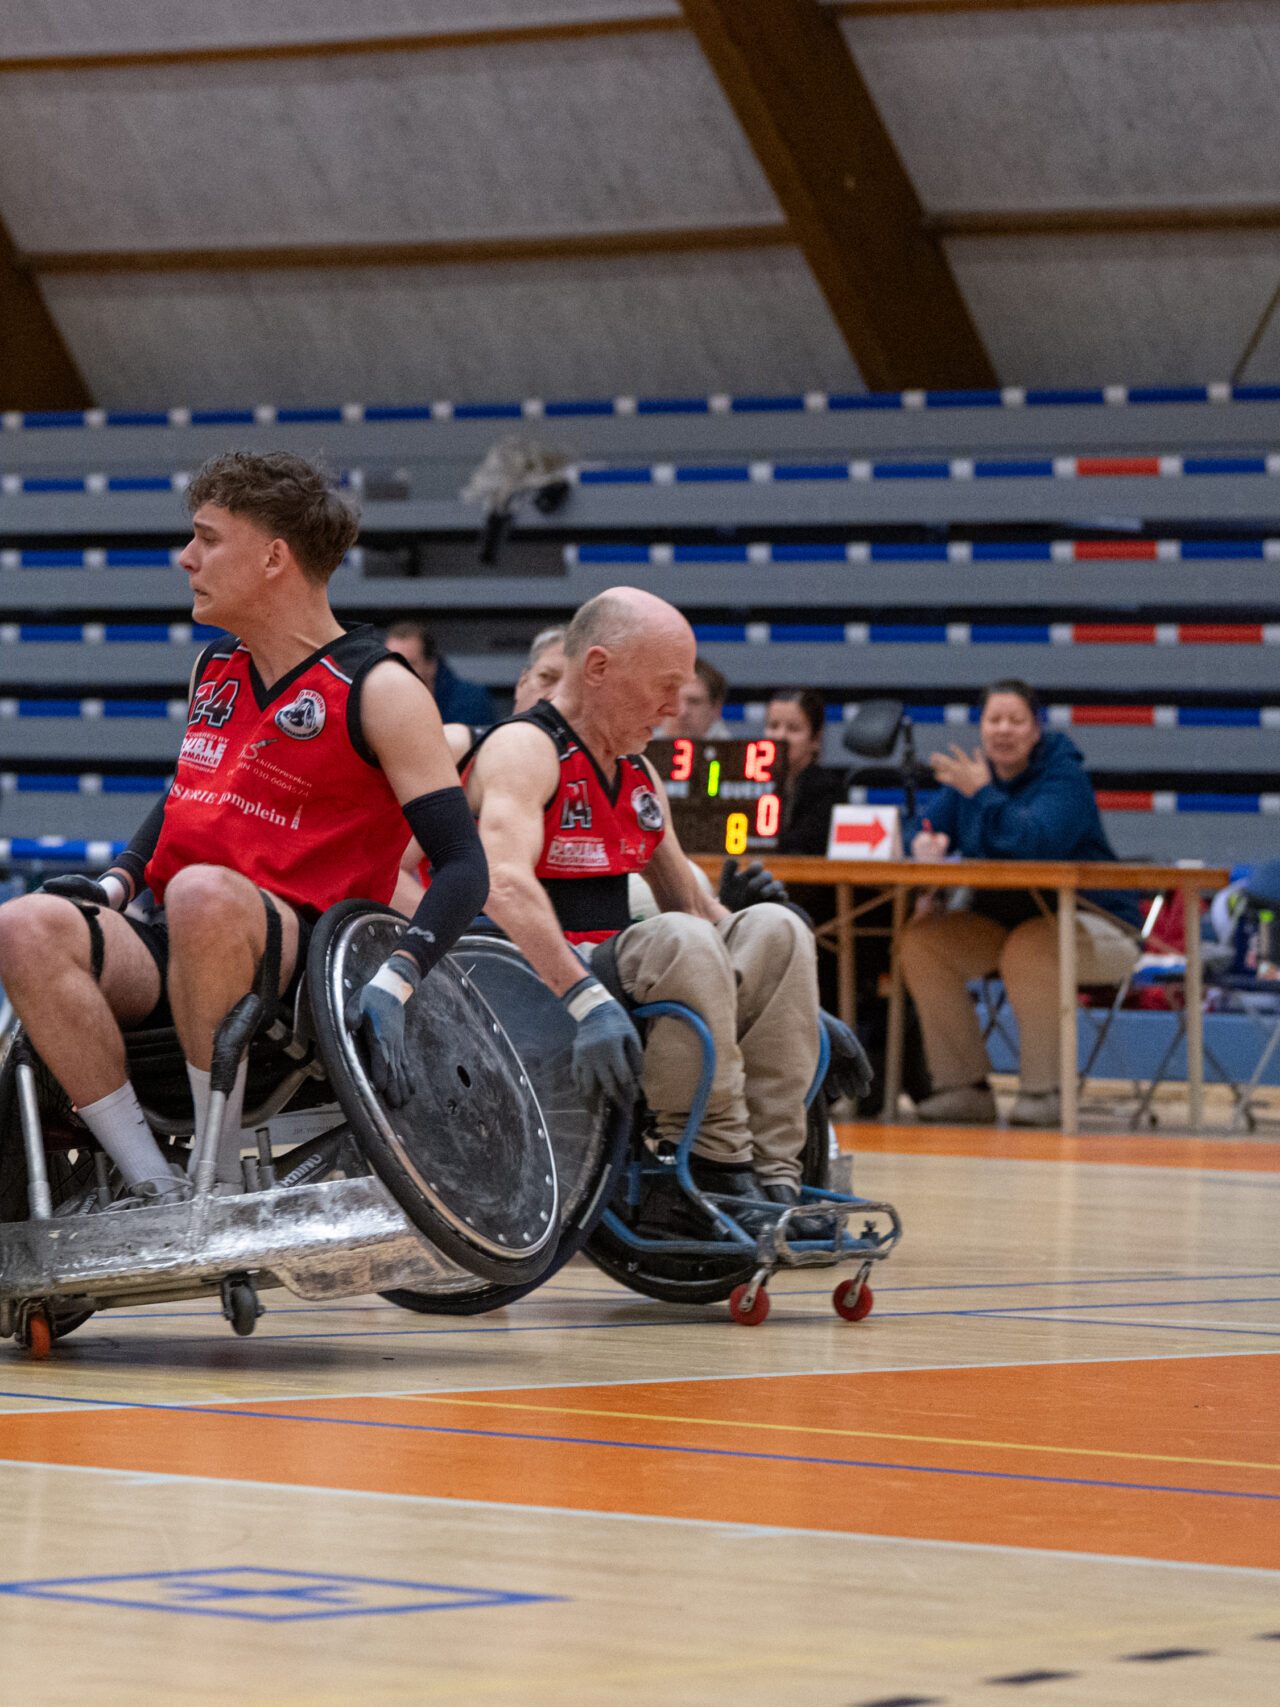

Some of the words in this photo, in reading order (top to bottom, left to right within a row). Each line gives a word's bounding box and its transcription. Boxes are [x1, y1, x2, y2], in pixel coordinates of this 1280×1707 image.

[188, 678, 240, 729] 24
[671, 738, 695, 782] 3
[707, 760, 721, 797] 1
[744, 739, 776, 782] 12
[725, 812, 749, 855] 8
[756, 793, 781, 837] 0
